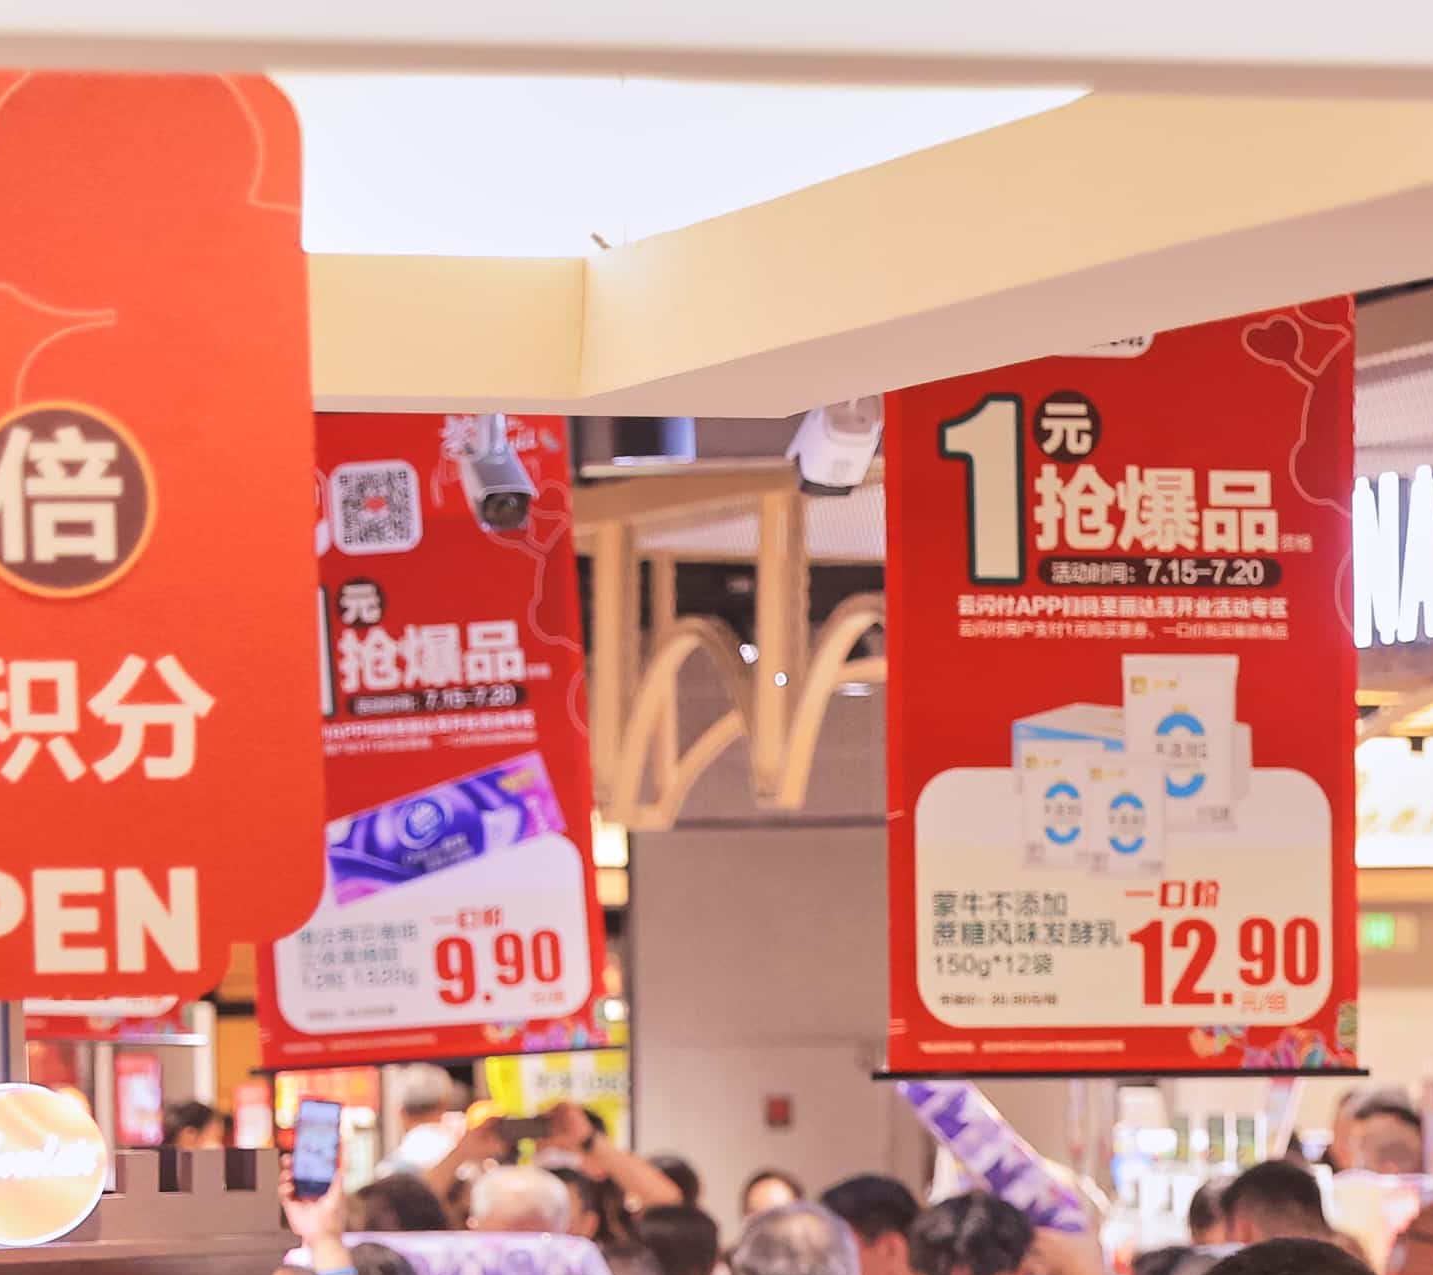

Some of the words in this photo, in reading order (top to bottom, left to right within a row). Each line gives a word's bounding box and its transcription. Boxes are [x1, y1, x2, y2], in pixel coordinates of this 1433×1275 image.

[1040, 402, 1094, 455] 元
[944, 400, 1021, 581] 1
[1034, 464, 1279, 552] 抢爆品
[339, 583, 382, 624] 元
[338, 619, 526, 692] 抢爆品
[434, 929, 561, 1005] 9.90
[1128, 917, 1320, 1006] 12.90
